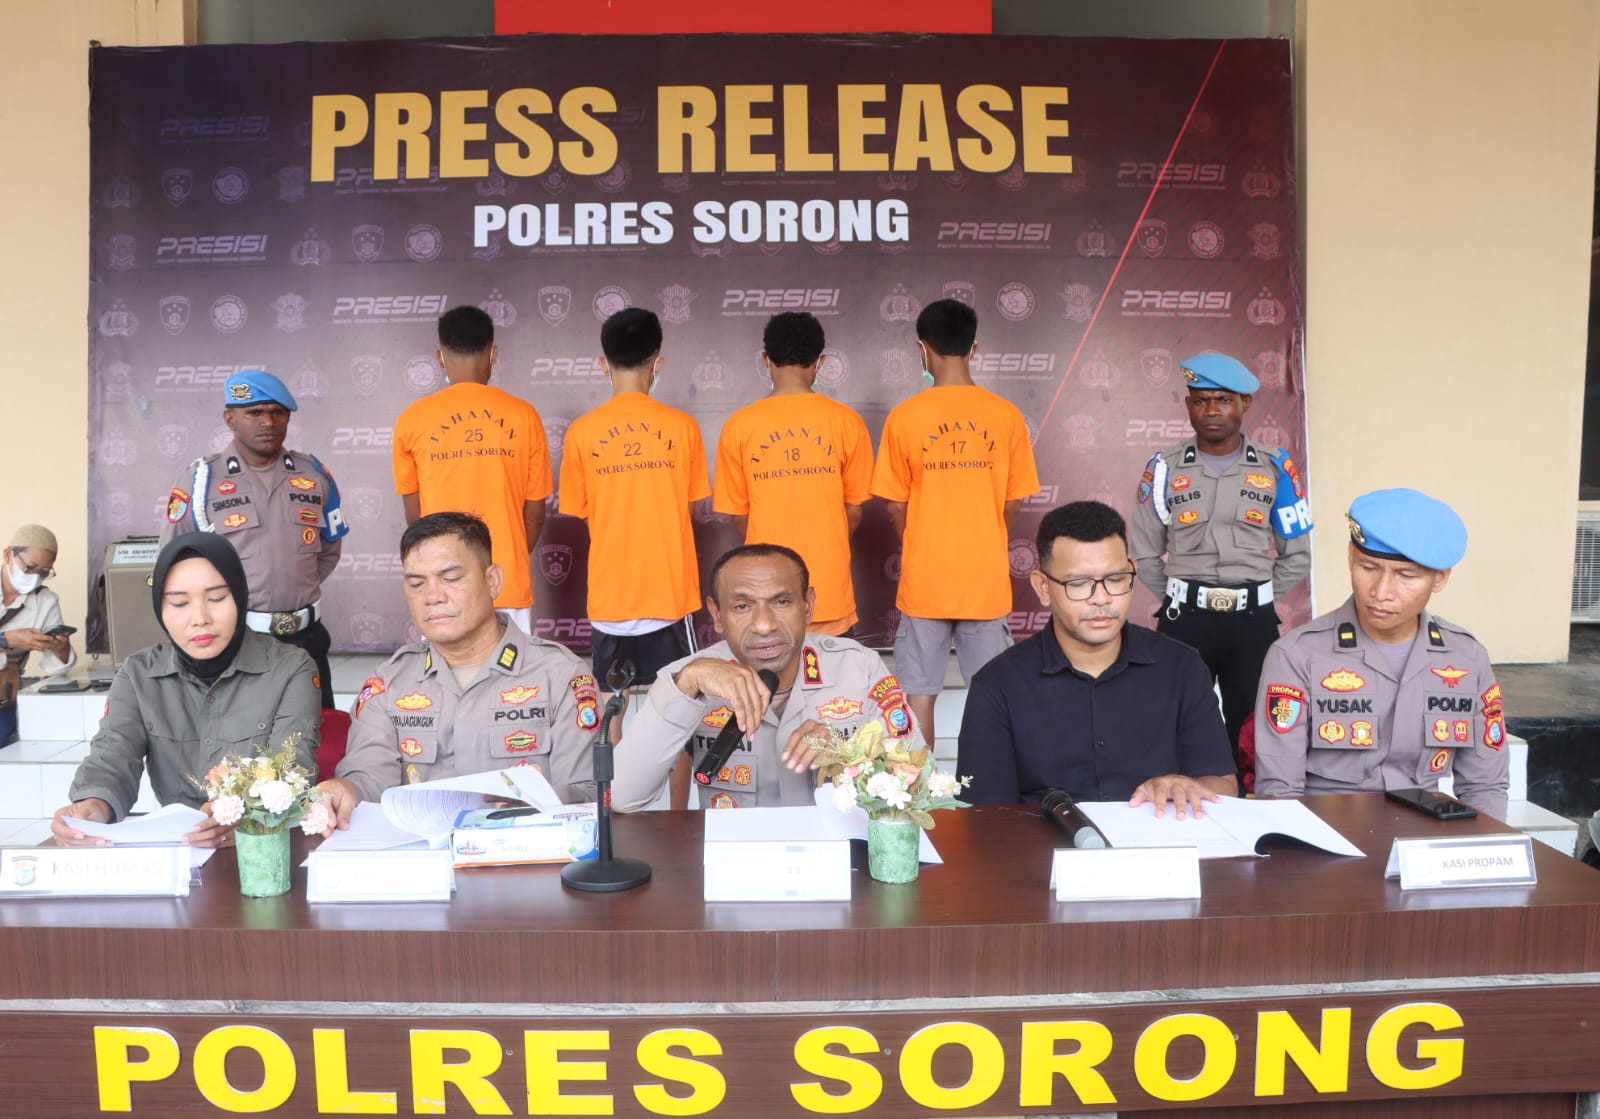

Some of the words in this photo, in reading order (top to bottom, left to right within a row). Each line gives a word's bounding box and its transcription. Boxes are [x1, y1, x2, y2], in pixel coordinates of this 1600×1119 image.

[310, 86, 618, 182] PRESS
[657, 84, 1073, 174] RELEASE
[1117, 161, 1227, 182] PRESISI
[474, 200, 673, 247] POLRES
[693, 199, 909, 243] SORONG
[937, 222, 1052, 242] PRESISI
[157, 234, 268, 255] PRESISI
[333, 295, 448, 316] PRESISI
[722, 288, 840, 308] PRESISI
[1121, 289, 1232, 310] PRESISI
[969, 353, 1056, 372] RESISI
[155, 364, 267, 385] PRES
[428, 408, 518, 443] TAHANAN
[1126, 418, 1196, 439] PRES
[464, 428, 484, 443] 25
[591, 421, 677, 458] TAHANAN
[623, 441, 642, 457] 22
[751, 426, 836, 464] TAHANAN
[950, 440, 967, 455] 17
[430, 448, 472, 461] POLRES
[784, 447, 801, 462] 18
[634, 460, 675, 471] SORONG
[753, 468, 791, 481] POLRES
[792, 465, 836, 476] SORONG
[289, 493, 322, 506] POLRI
[1168, 490, 1201, 507] FELIS
[1240, 489, 1273, 505] POLRI
[1271, 685, 1302, 697] PROPAM
[1316, 698, 1374, 714] YUSAK
[1427, 695, 1473, 713] POLRI
[494, 707, 546, 722] POLRI
[52, 861, 90, 876] KASI
[96, 859, 161, 876] HUMAS
[1441, 858, 1467, 869] KASI
[1468, 856, 1514, 868] PROPAM
[93, 1024, 728, 1115] POLRES
[790, 1002, 1466, 1114] SORONG
